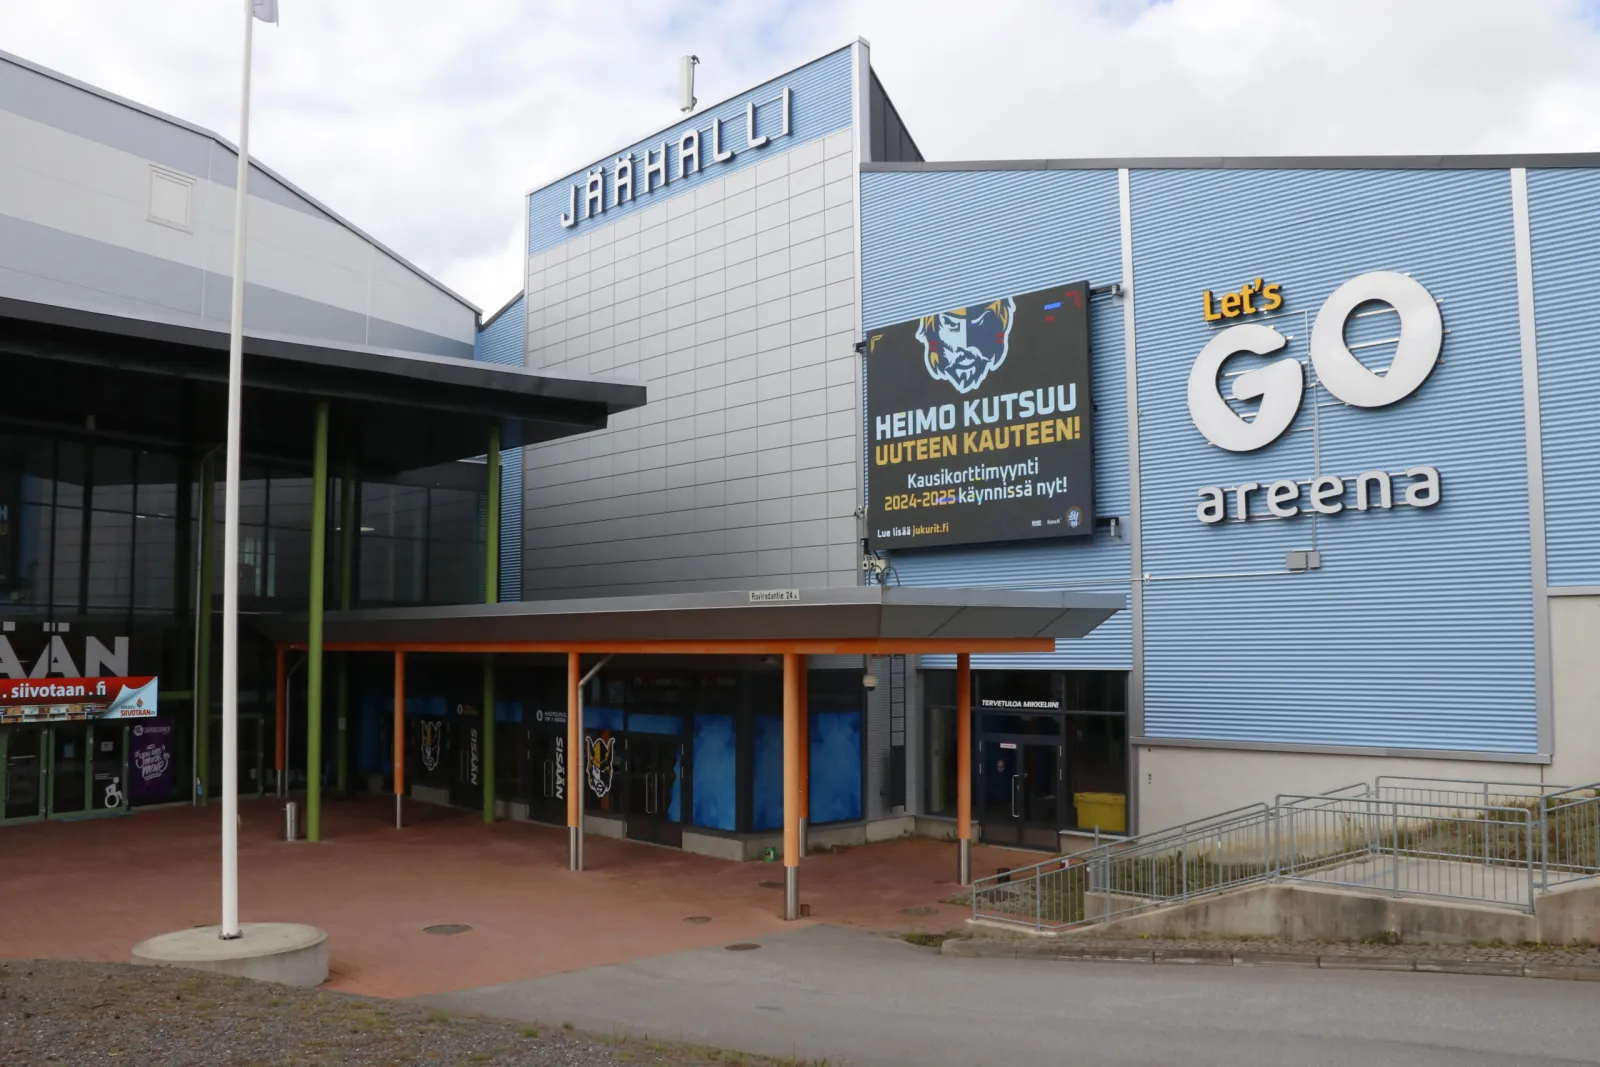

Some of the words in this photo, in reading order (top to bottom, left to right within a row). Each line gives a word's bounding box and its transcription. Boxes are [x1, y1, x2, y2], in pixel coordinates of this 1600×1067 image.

[561, 87, 791, 228] JÄÄHALLI
[1203, 277, 1282, 322] Let's
[1187, 270, 1443, 452] GO
[876, 404, 956, 440] HEIMO
[964, 383, 1077, 427] KUTSUU
[875, 434, 957, 466] UUTEEN
[963, 416, 1081, 454] KAUTEEN!
[884, 489, 956, 511] 2024-2025
[959, 482, 1033, 505] käynnissä
[1037, 476, 1067, 498] nyt!
[908, 457, 1039, 488] Kausikorttimyynti
[1196, 466, 1441, 524] areena
[877, 529, 890, 538] Lue
[893, 527, 911, 536] lisää
[912, 522, 949, 537] jukurit.fi
[751, 592, 784, 600] Raviradantie
[786, 591, 793, 599] 24
[120, 709, 151, 717] SIIVOTAAN
[982, 699, 1022, 708] TERVETULOA
[1023, 701, 1060, 709] MIKKELIIN!
[470, 727, 478, 785] SISÄÄN
[556, 736, 565, 799] SISÄÄN
